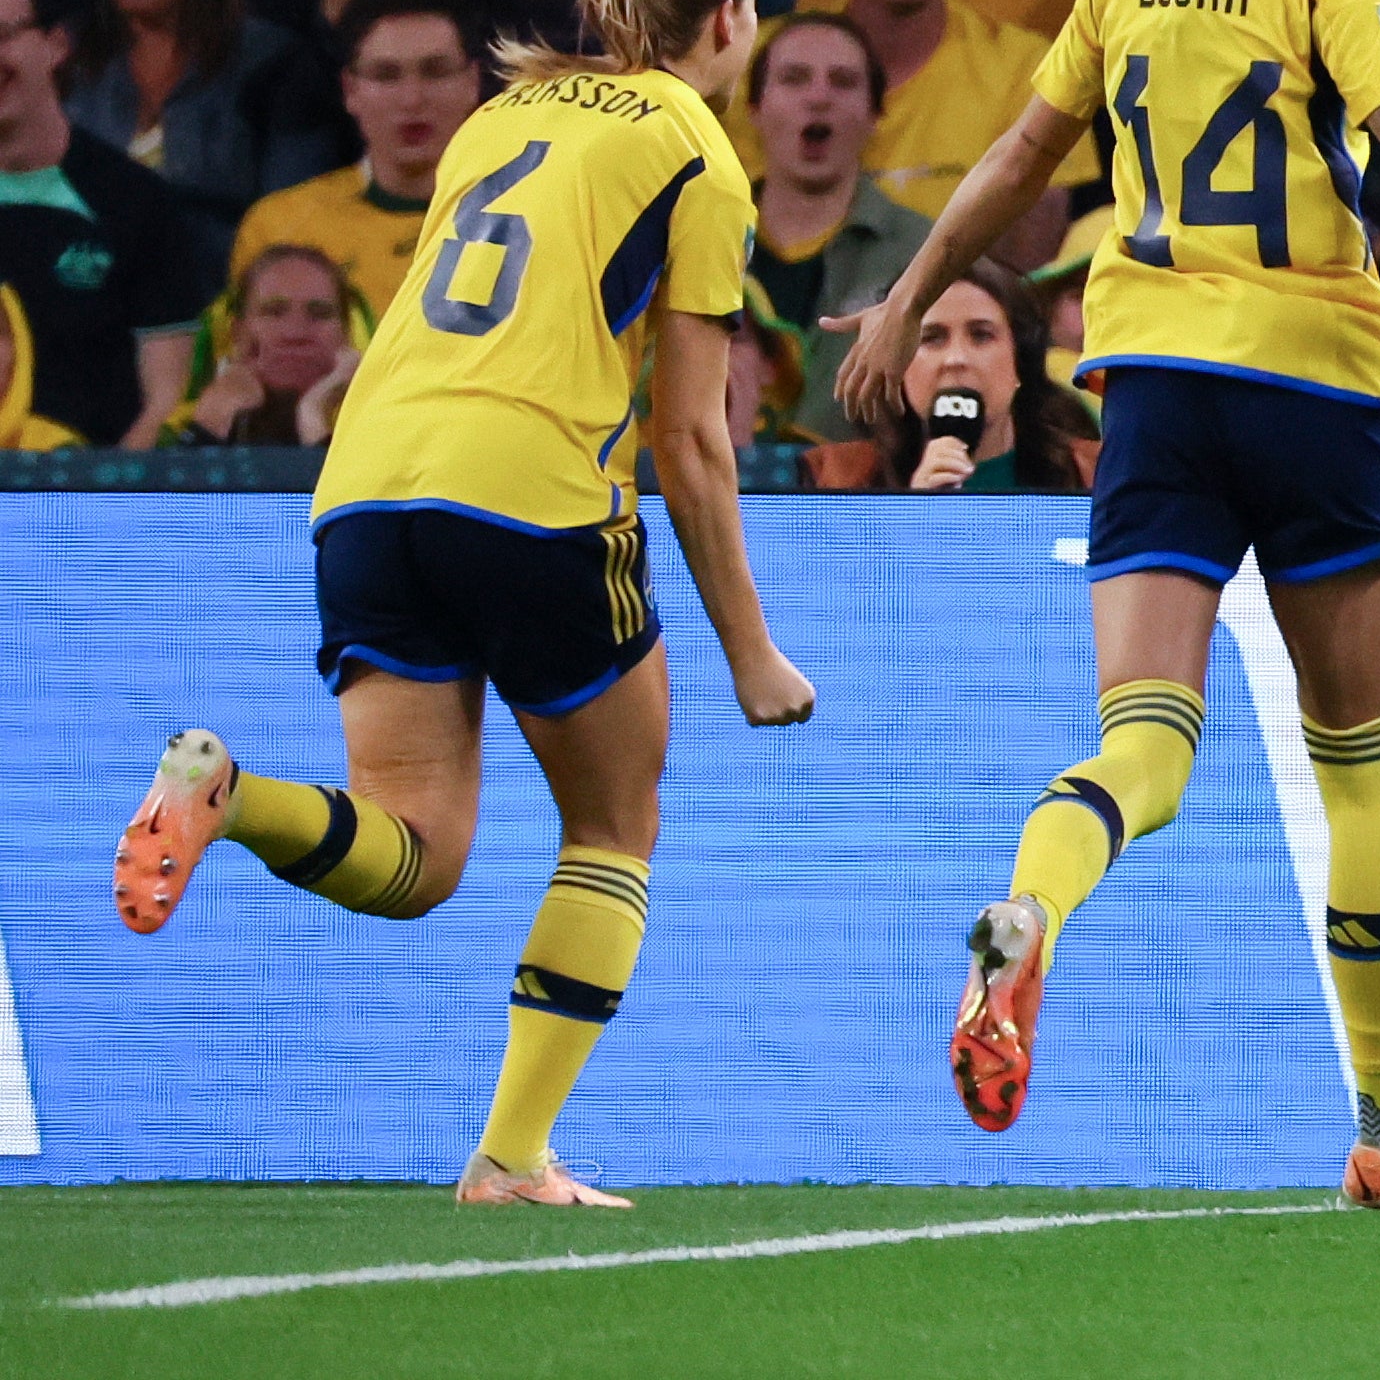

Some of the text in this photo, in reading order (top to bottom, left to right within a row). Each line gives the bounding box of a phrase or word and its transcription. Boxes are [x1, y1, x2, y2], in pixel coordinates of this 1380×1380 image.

[484, 75, 663, 123] RIKSSON
[1113, 54, 1292, 268] 14
[422, 140, 552, 336] 6
